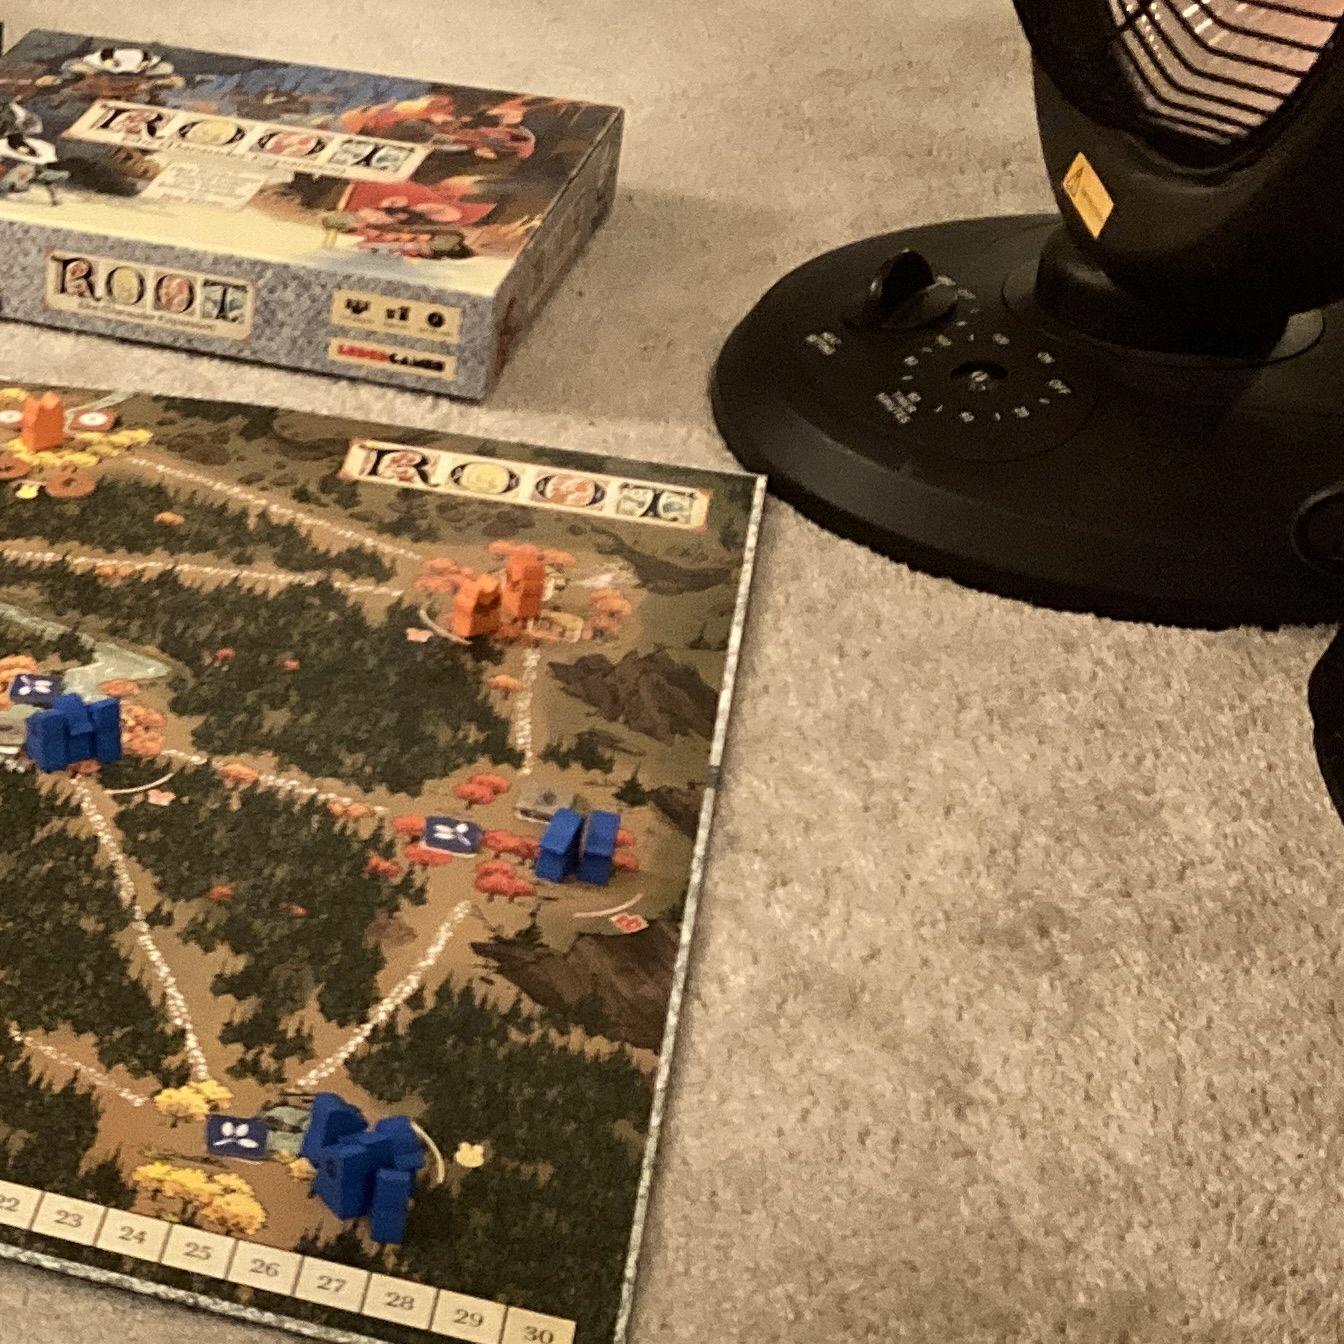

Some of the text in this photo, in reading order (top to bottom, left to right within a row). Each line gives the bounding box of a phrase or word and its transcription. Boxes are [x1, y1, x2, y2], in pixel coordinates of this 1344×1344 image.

[89, 104, 415, 170] ROOT
[51, 255, 249, 323] ROOT
[362, 446, 695, 521] ROOT
[53, 1210, 84, 1228] 23
[118, 1226, 147, 1244] 24
[183, 1242, 212, 1261] 25
[249, 1258, 280, 1277] 26
[316, 1275, 347, 1293] 27
[384, 1292, 415, 1311] 28
[452, 1308, 484, 1328] 29
[524, 1326, 554, 1344] 30
